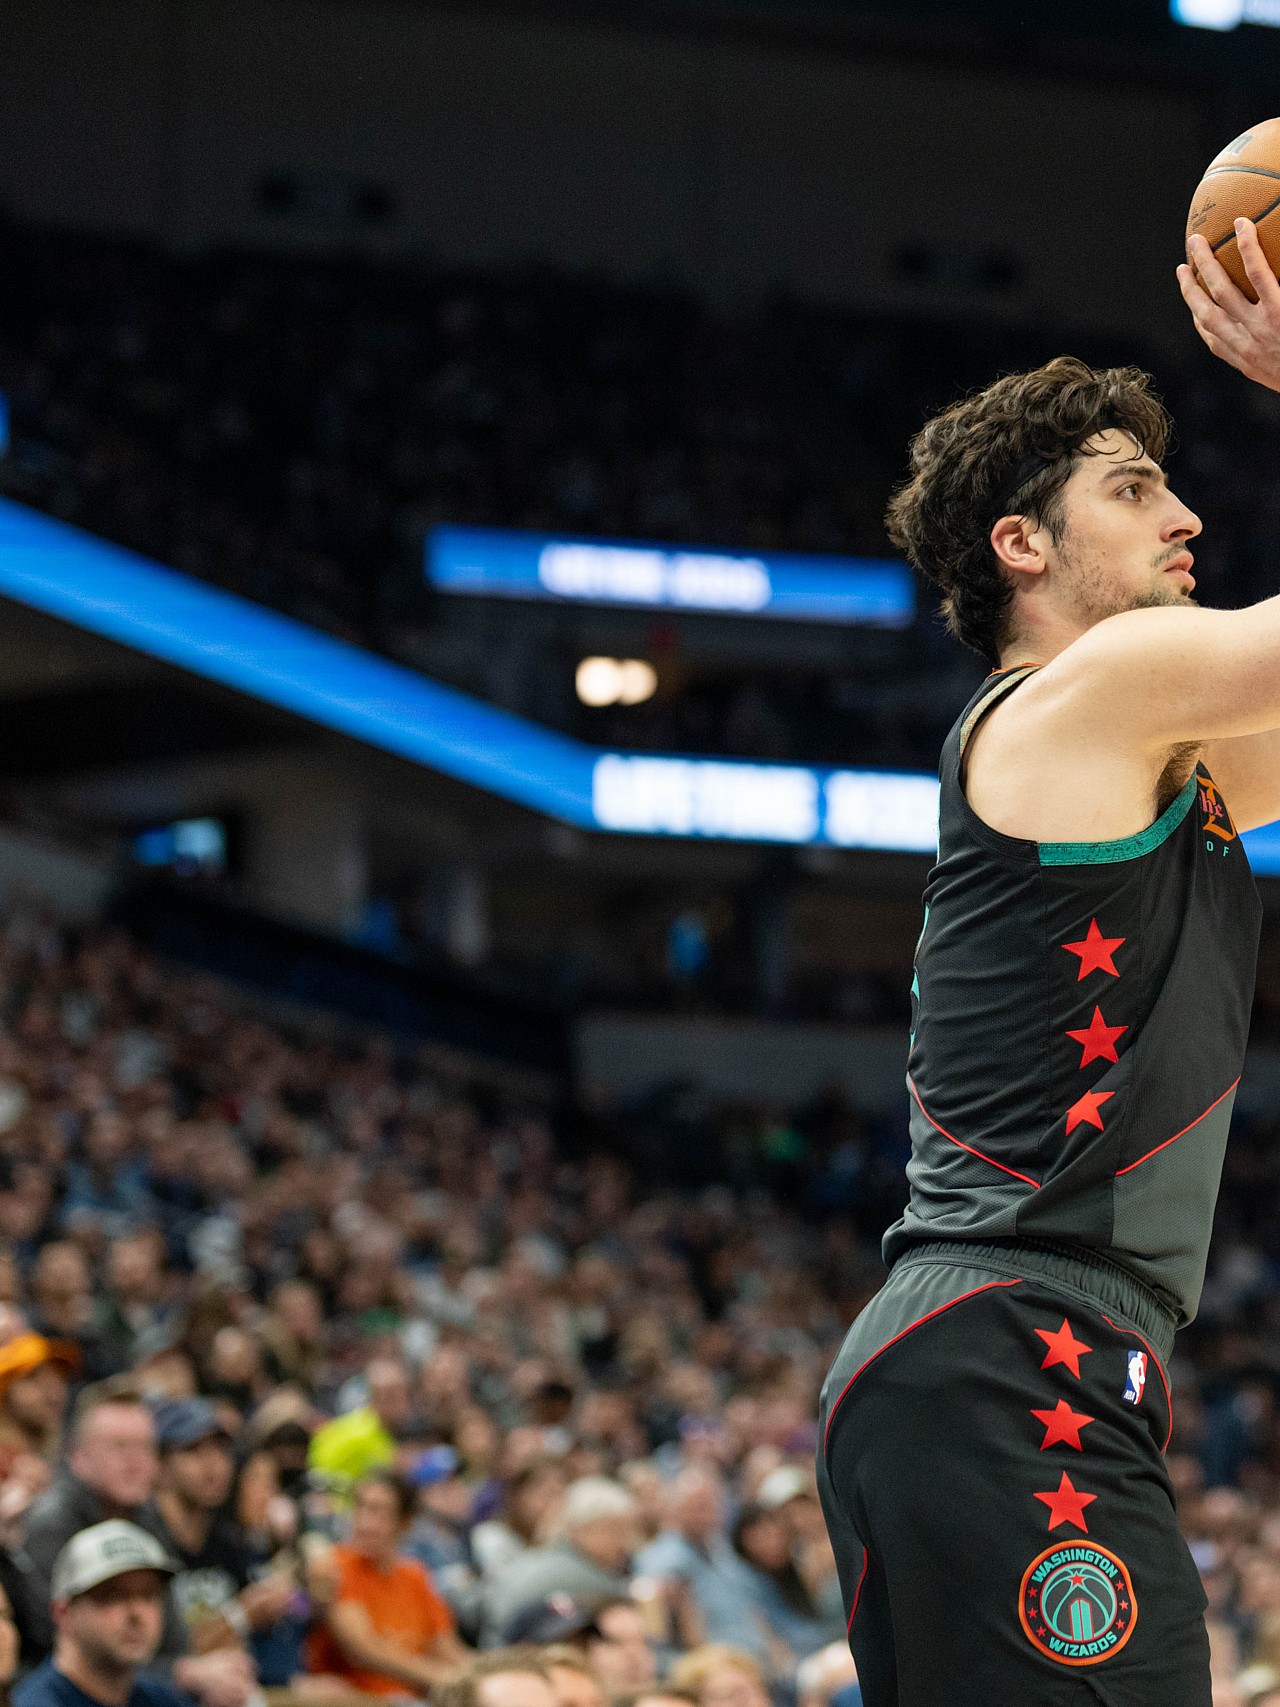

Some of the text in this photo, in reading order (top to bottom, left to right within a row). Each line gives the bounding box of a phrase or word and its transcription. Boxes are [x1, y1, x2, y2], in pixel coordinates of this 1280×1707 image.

[1206, 840, 1230, 857] OF
[1031, 1548, 1119, 1584] WASHINGTON
[1049, 1631, 1118, 1657] WIZARDS
